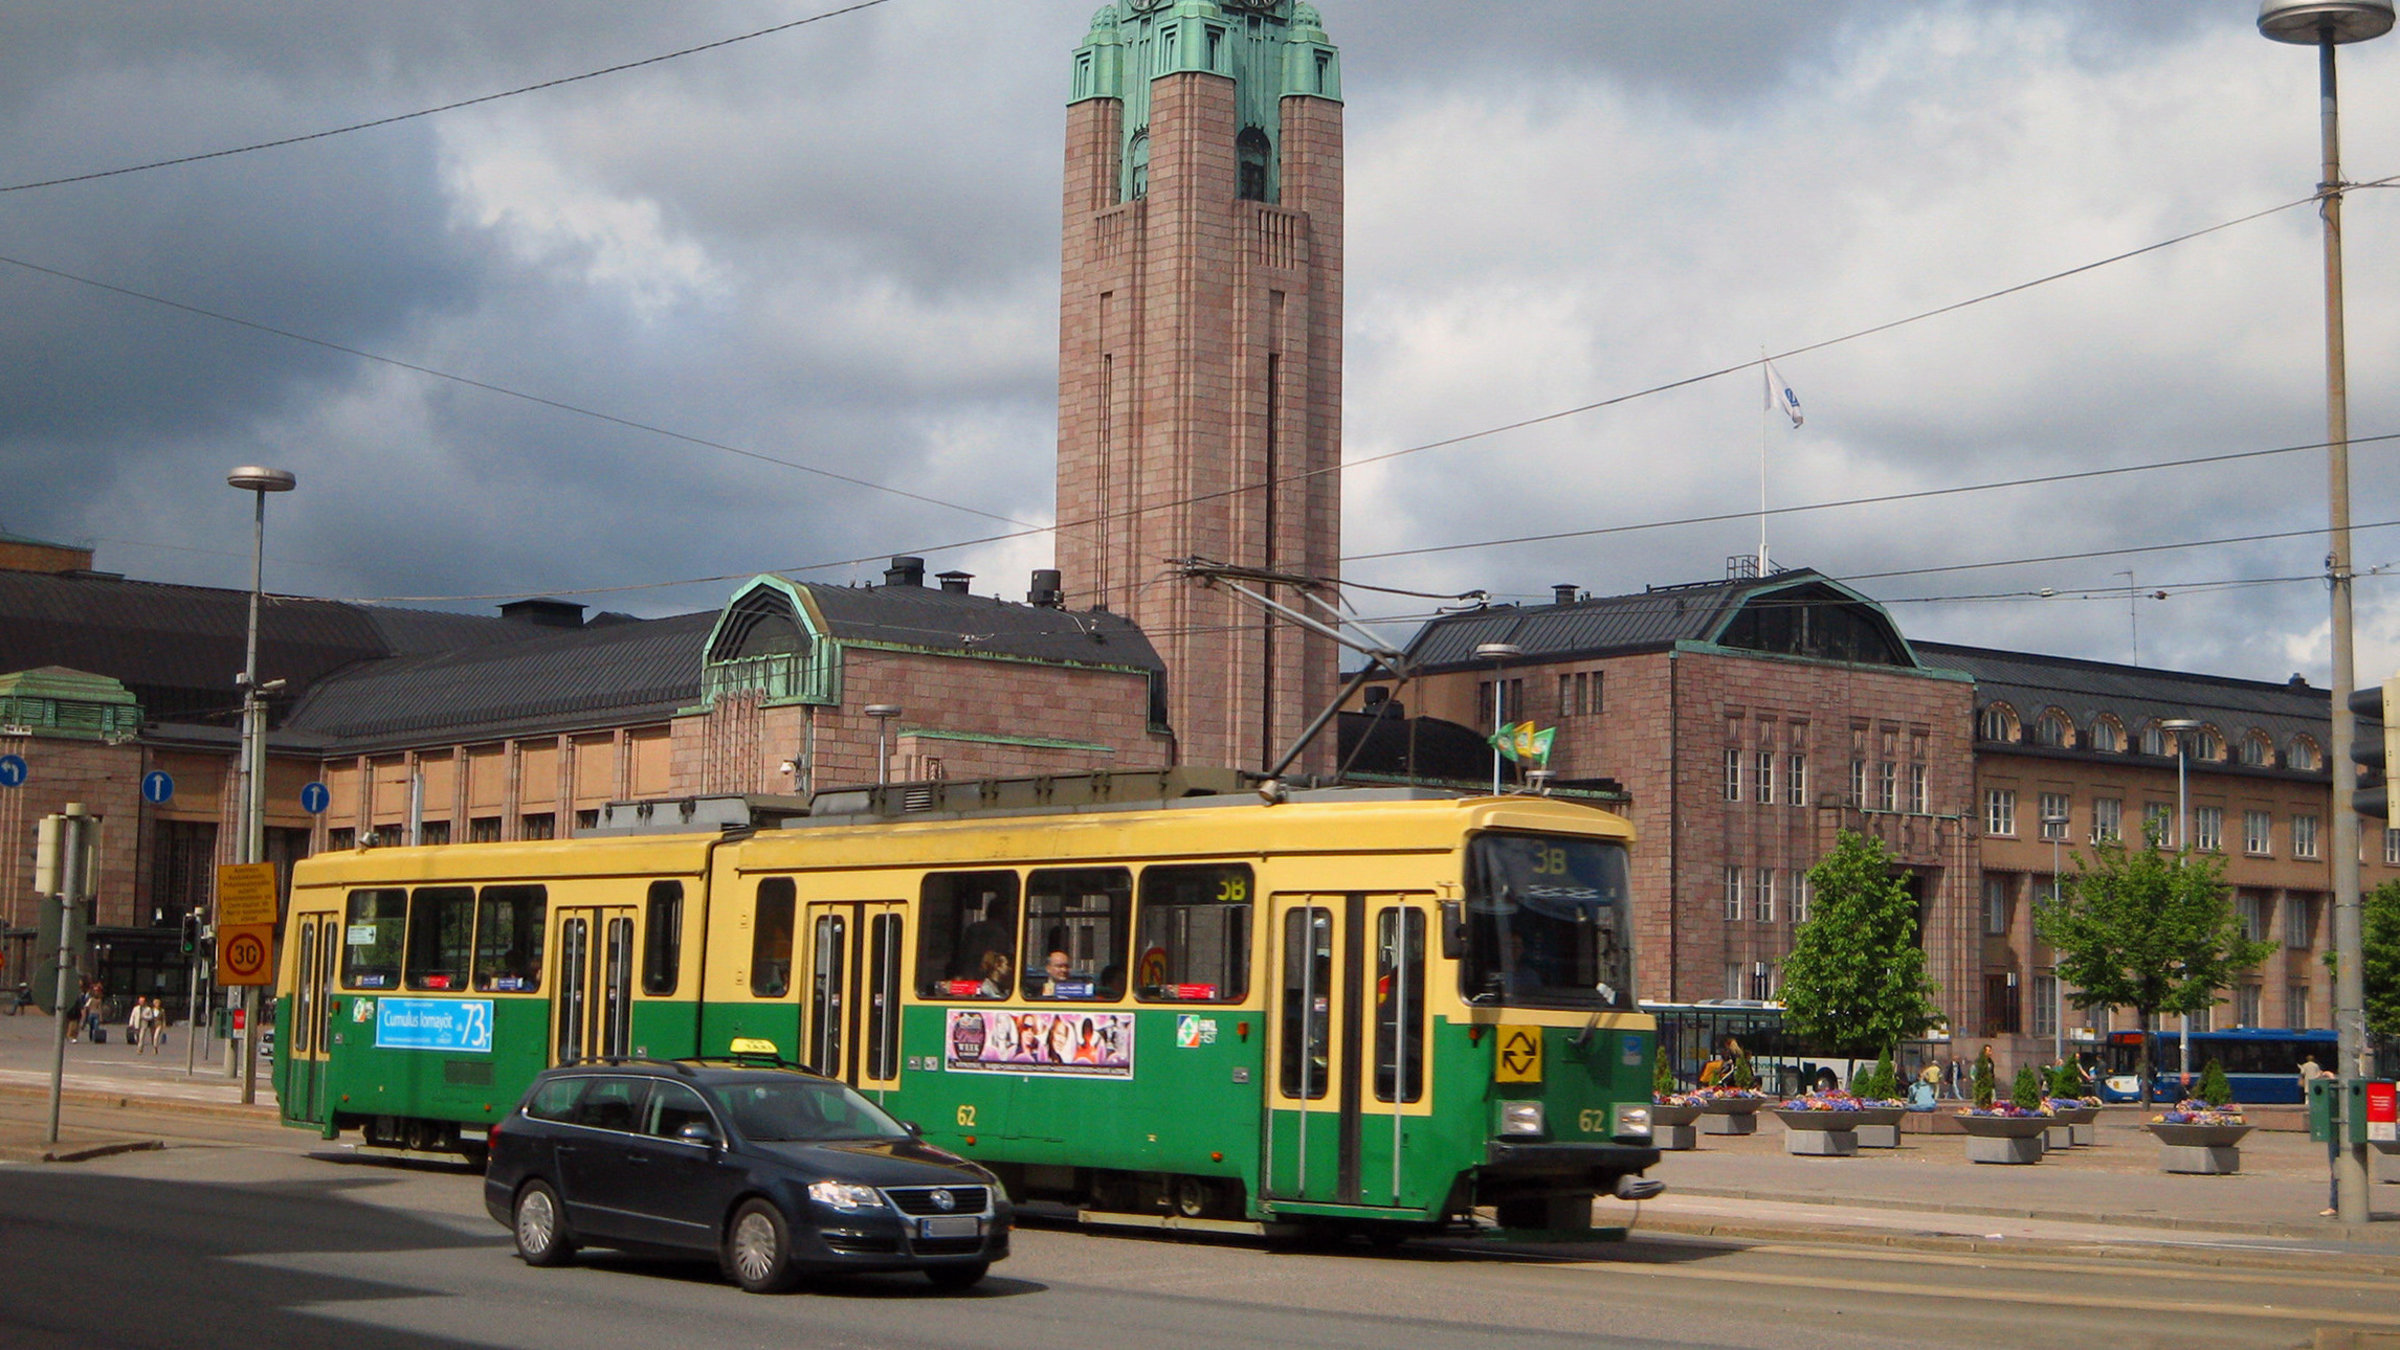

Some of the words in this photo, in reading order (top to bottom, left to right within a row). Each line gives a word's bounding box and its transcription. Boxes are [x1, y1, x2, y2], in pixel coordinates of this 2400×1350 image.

[1531, 840, 1567, 875] 3B
[234, 944, 258, 965] 30
[384, 1010, 419, 1028] Cumulus
[957, 1104, 977, 1127] 62
[1579, 1109, 1606, 1132] 62
